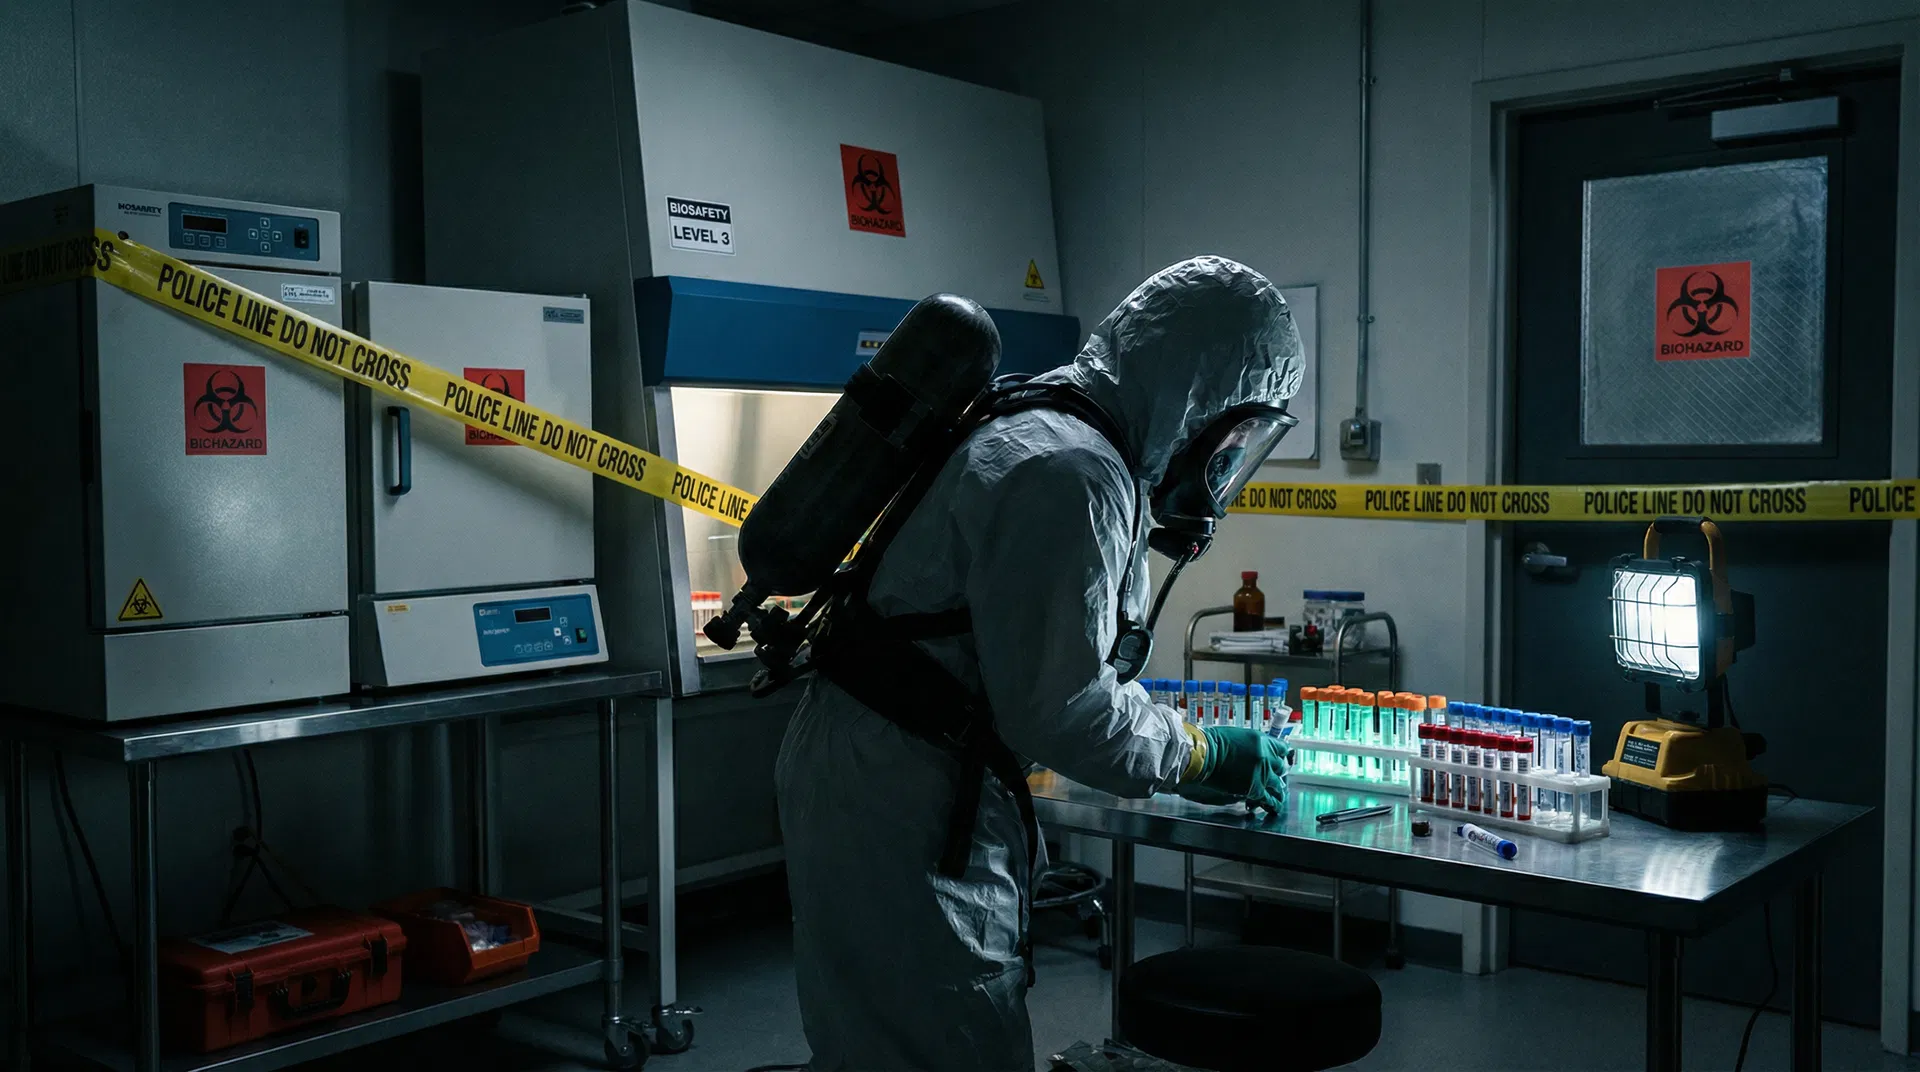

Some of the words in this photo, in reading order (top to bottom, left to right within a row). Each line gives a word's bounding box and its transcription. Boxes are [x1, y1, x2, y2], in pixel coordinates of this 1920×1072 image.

[669, 201, 729, 221] BIOSAFETY
[673, 225, 718, 244] LEVEL
[721, 231, 730, 246] 3
[65, 235, 113, 272] CROSS
[157, 263, 231, 318] POLICE
[232, 294, 278, 337] LINE
[279, 314, 308, 349] DO
[310, 326, 351, 365] NOT
[352, 344, 411, 391] CROSS
[1661, 340, 1744, 355] BIOHAZARD
[444, 381, 502, 427] POLICE
[502, 405, 539, 441] LINE
[540, 419, 563, 450] DO
[564, 429, 597, 462] NOT
[597, 442, 646, 481] CROSS
[671, 471, 718, 510] POLICE
[718, 490, 749, 521] LINE
[1249, 488, 1266, 508] DO
[1269, 488, 1293, 509] NOT
[1296, 489, 1337, 510] CROSS
[1365, 490, 1410, 512] POLICE
[1414, 491, 1443, 512] LINE
[1447, 491, 1466, 513] DO
[1470, 491, 1497, 513] NOT
[1502, 492, 1550, 514] CROSS
[1584, 491, 1638, 514] POLICE
[1643, 490, 1678, 514] LINE
[1683, 490, 1705, 514] DO
[1710, 489, 1743, 514] NOT
[1749, 488, 1806, 514] CROSS
[1850, 486, 1916, 513] POLICE
